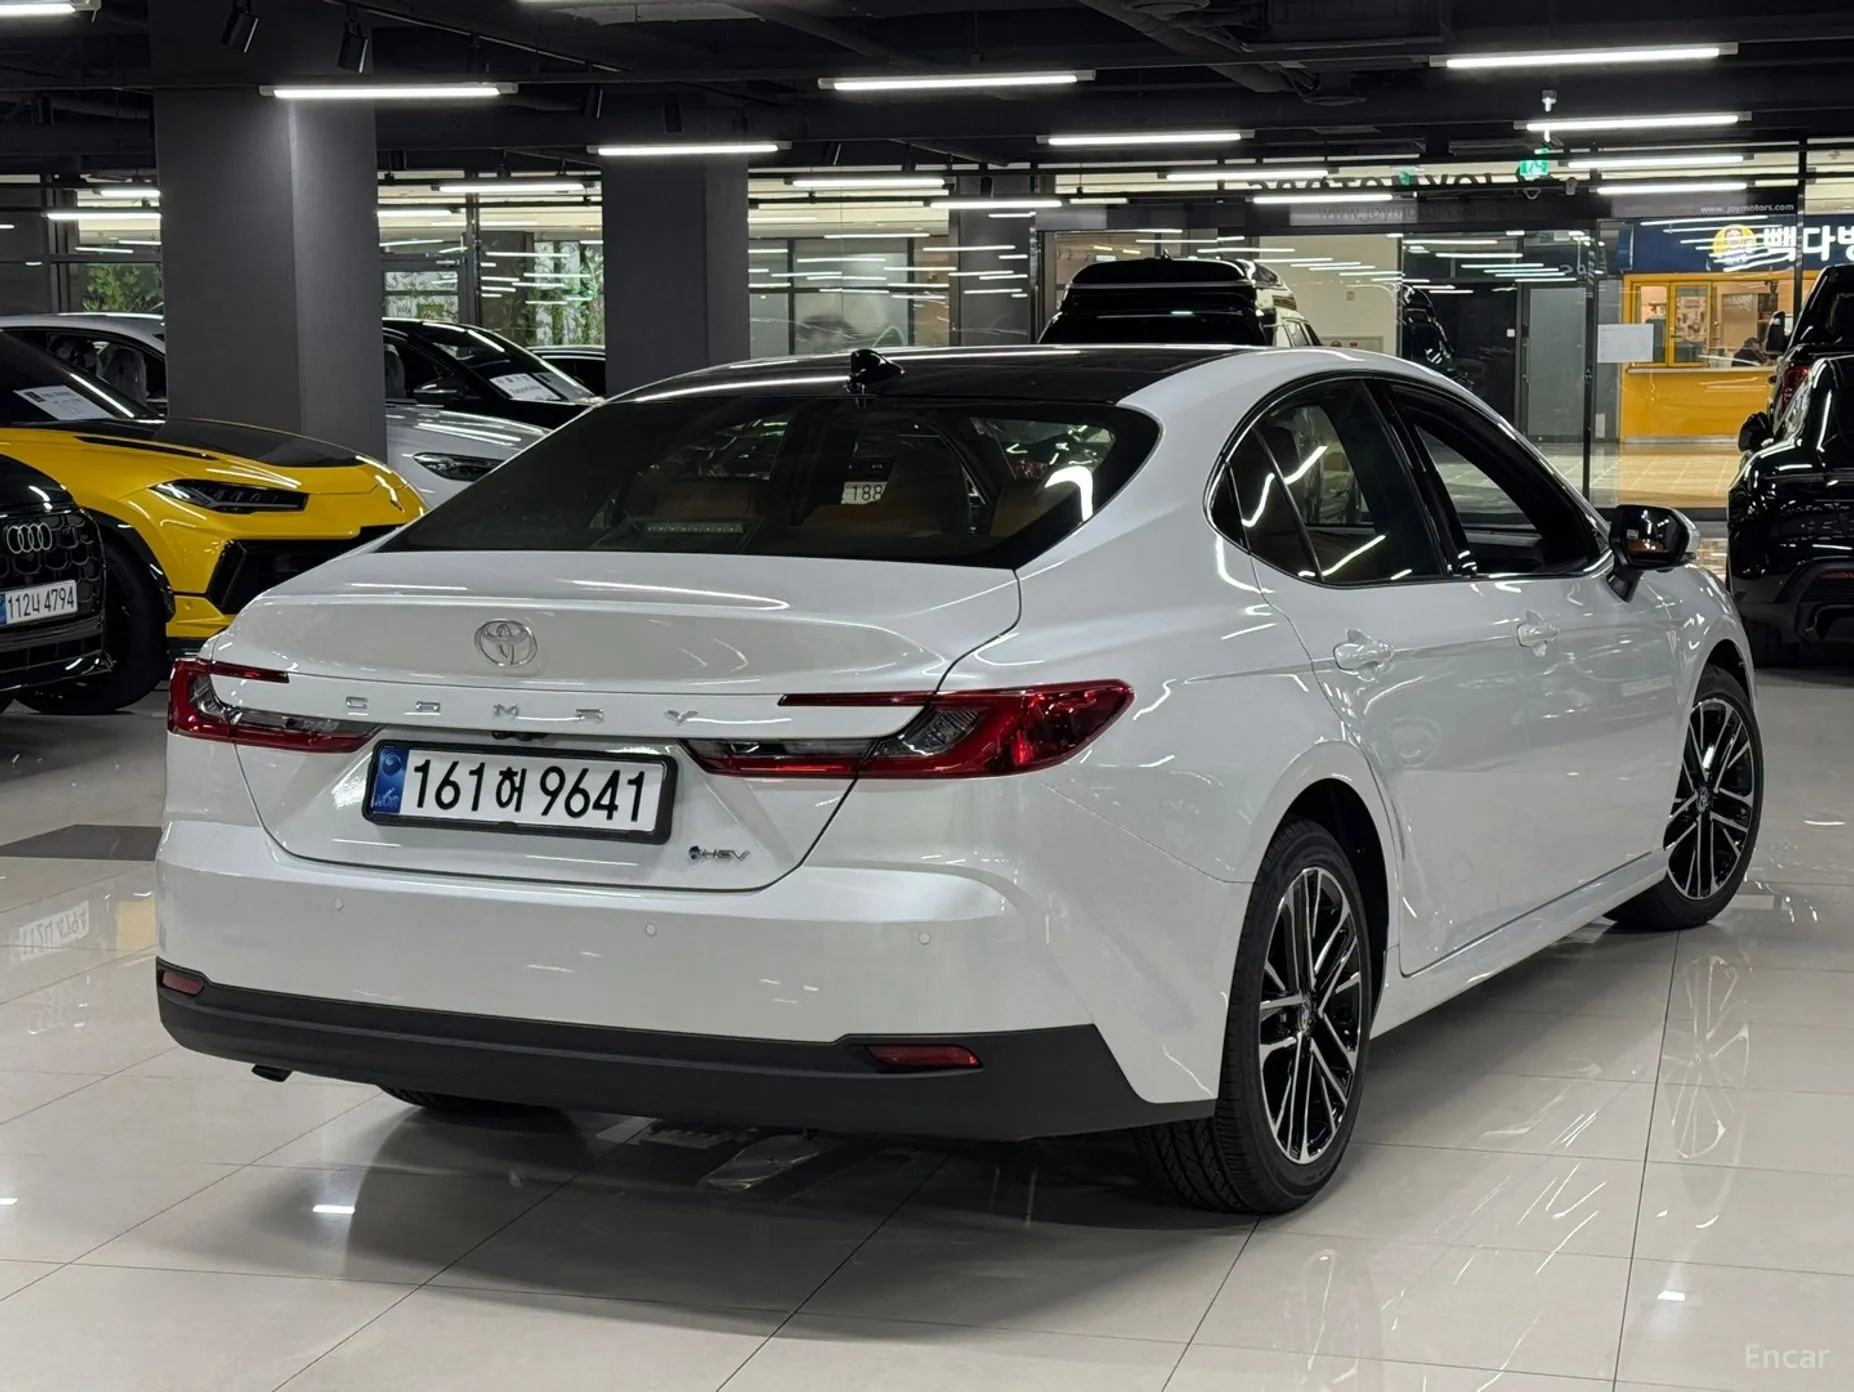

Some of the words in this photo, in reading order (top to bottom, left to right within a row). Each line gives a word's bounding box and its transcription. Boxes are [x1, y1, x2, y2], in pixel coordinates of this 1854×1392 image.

[44, 586, 74, 612] 4794
[345, 696, 699, 725] CAMRY
[413, 759, 528, 813] 161허
[540, 765, 646, 822] 9641
[701, 849, 750, 862] HEV
